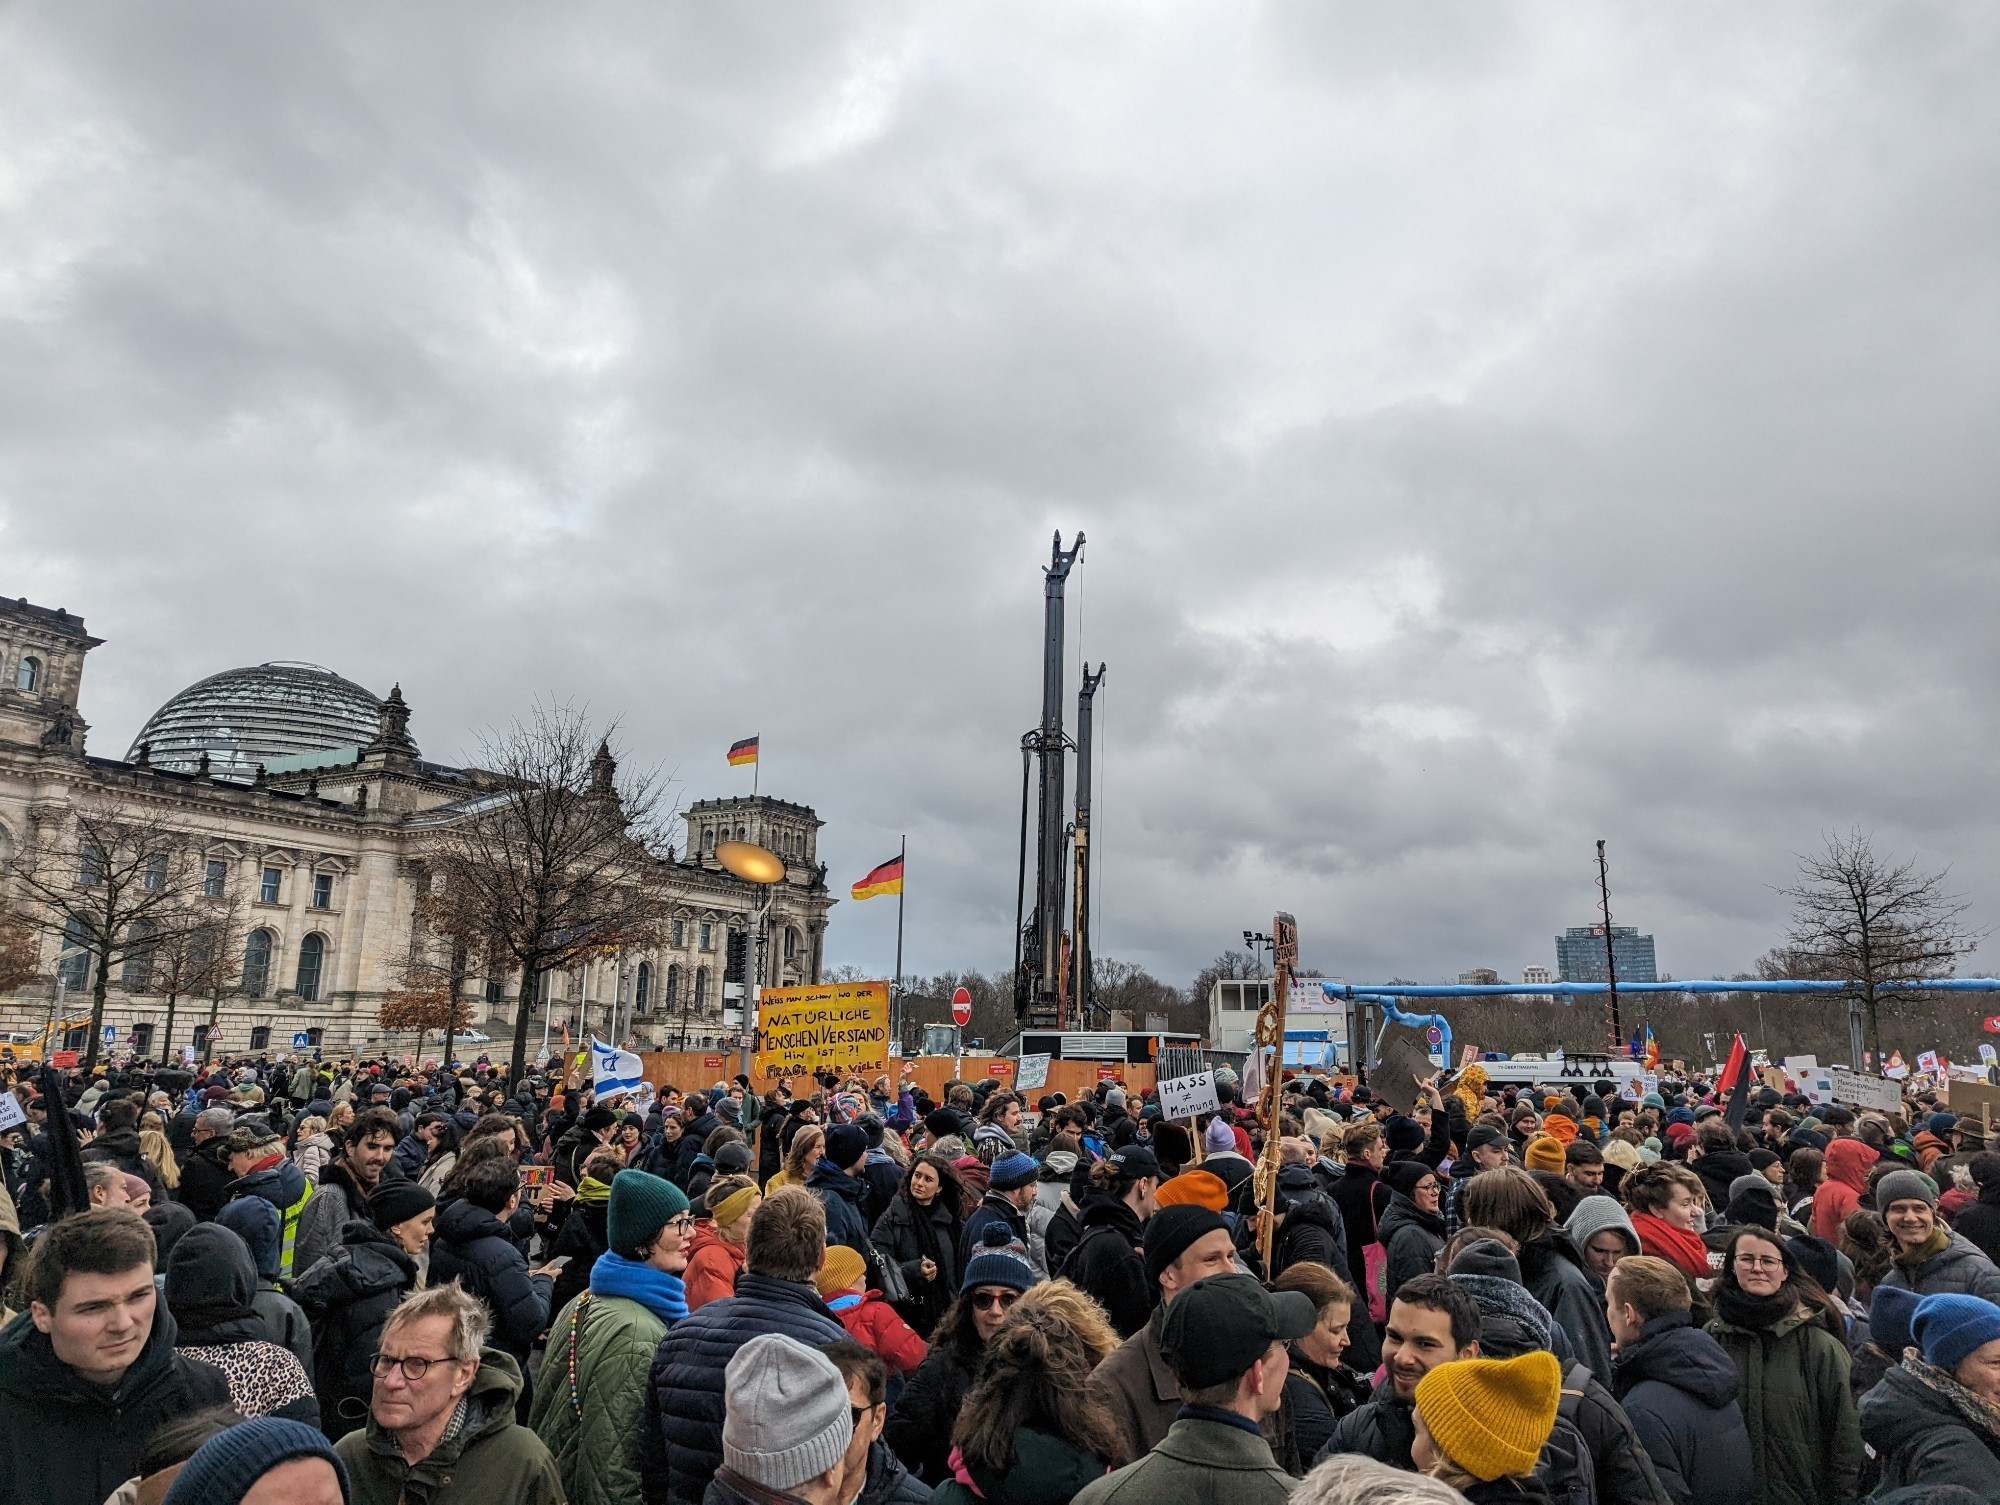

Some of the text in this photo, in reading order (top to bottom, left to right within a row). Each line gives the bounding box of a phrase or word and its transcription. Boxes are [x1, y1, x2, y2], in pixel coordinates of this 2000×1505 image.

[805, 994, 831, 1002] SCHON
[768, 1010, 871, 1027] NATÜRLICHE
[766, 1064, 807, 1078] FRAGE
[1164, 1075, 1207, 1095] HASS
[1170, 1100, 1214, 1117] Meinung
